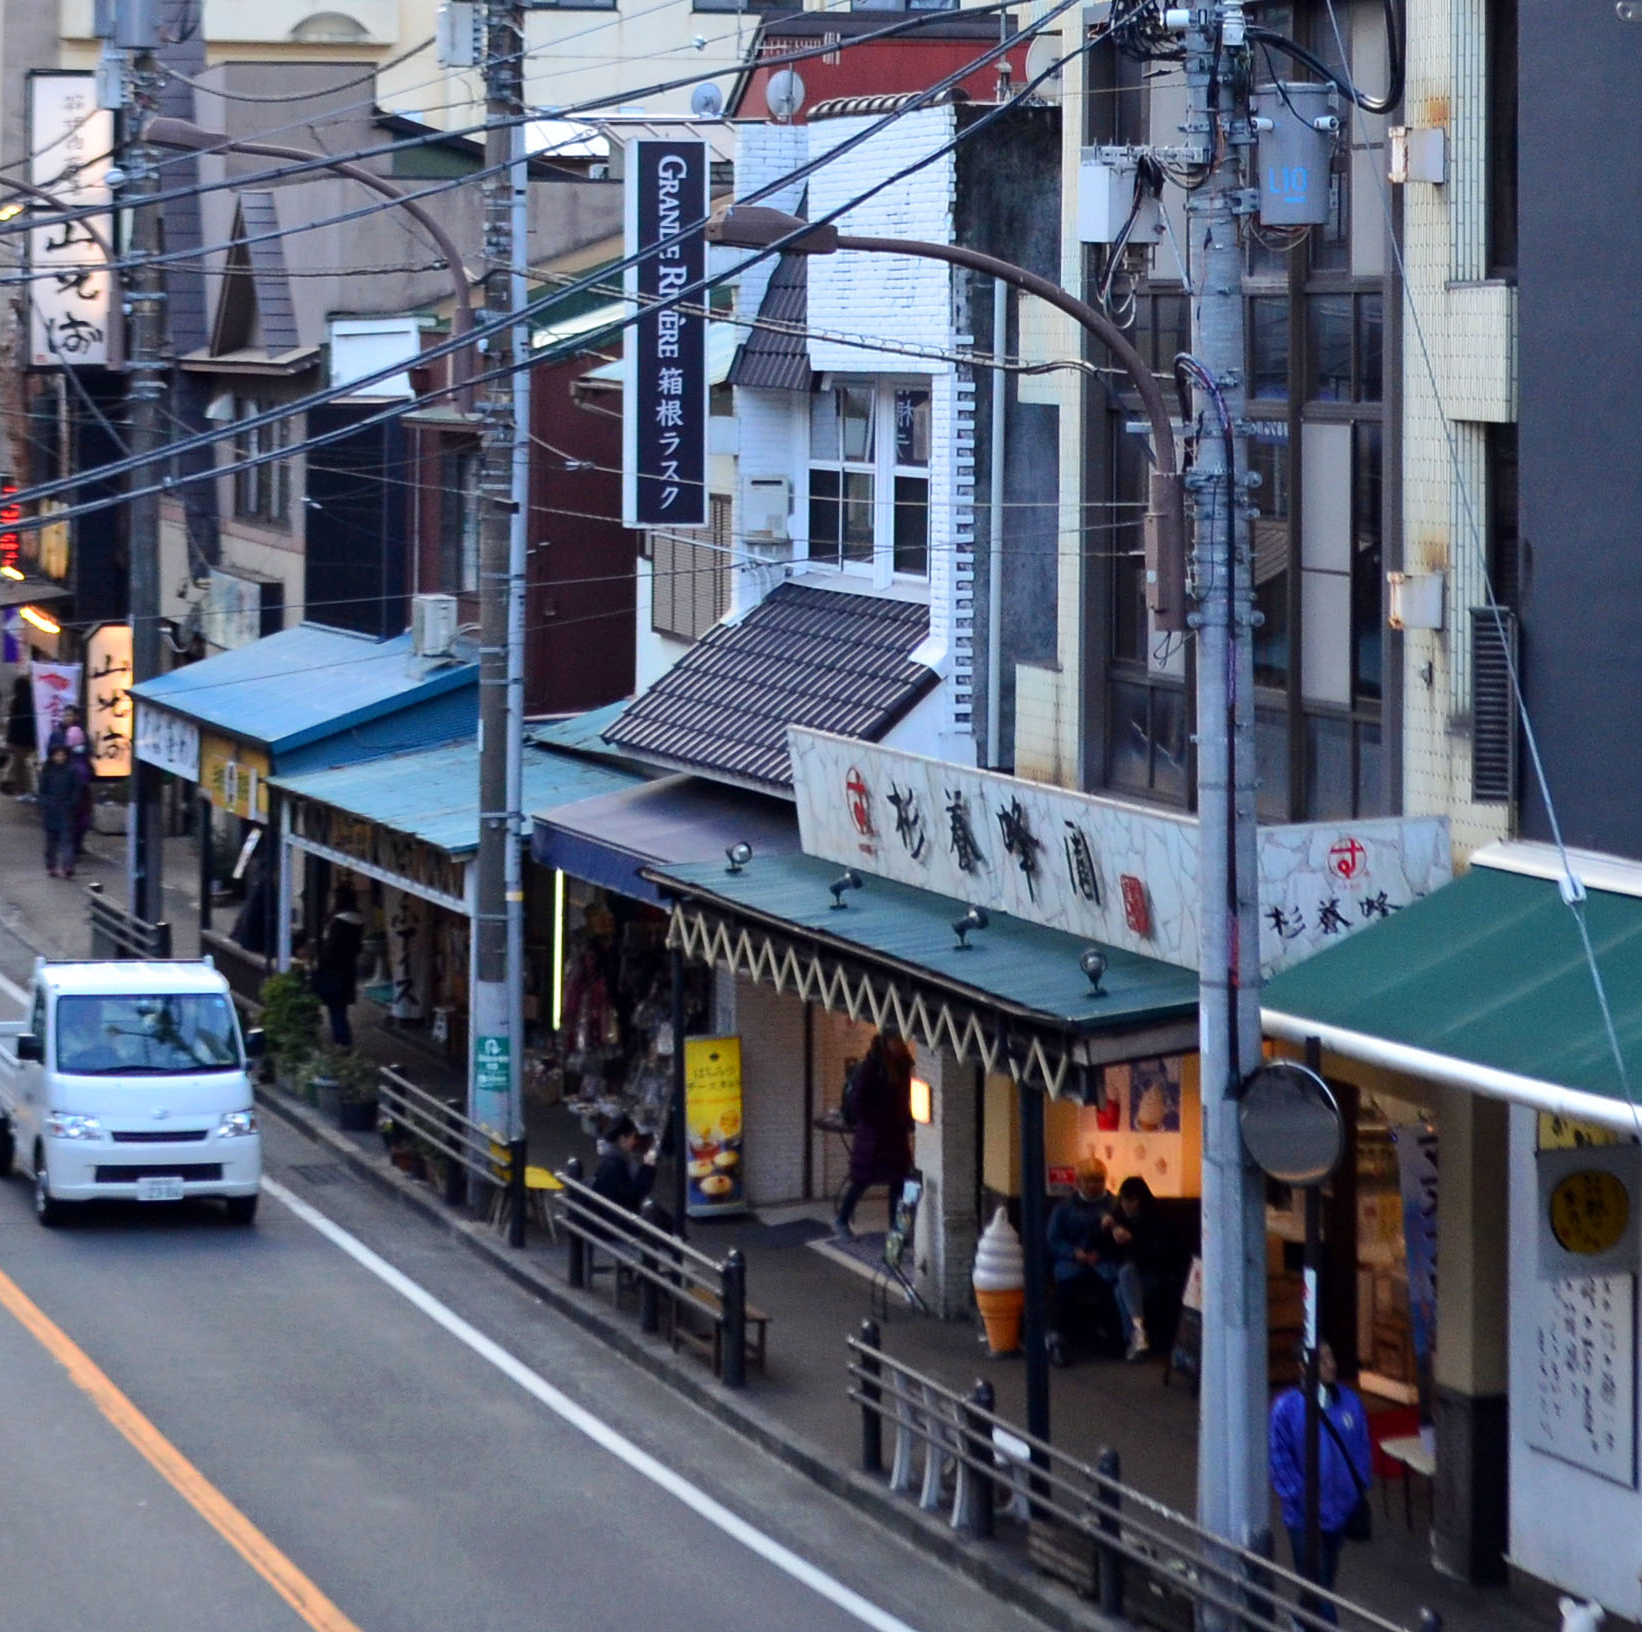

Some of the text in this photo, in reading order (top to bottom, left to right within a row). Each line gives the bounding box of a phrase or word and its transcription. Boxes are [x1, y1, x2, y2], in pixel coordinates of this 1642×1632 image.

[655, 366, 684, 511] 箱根ラスク
